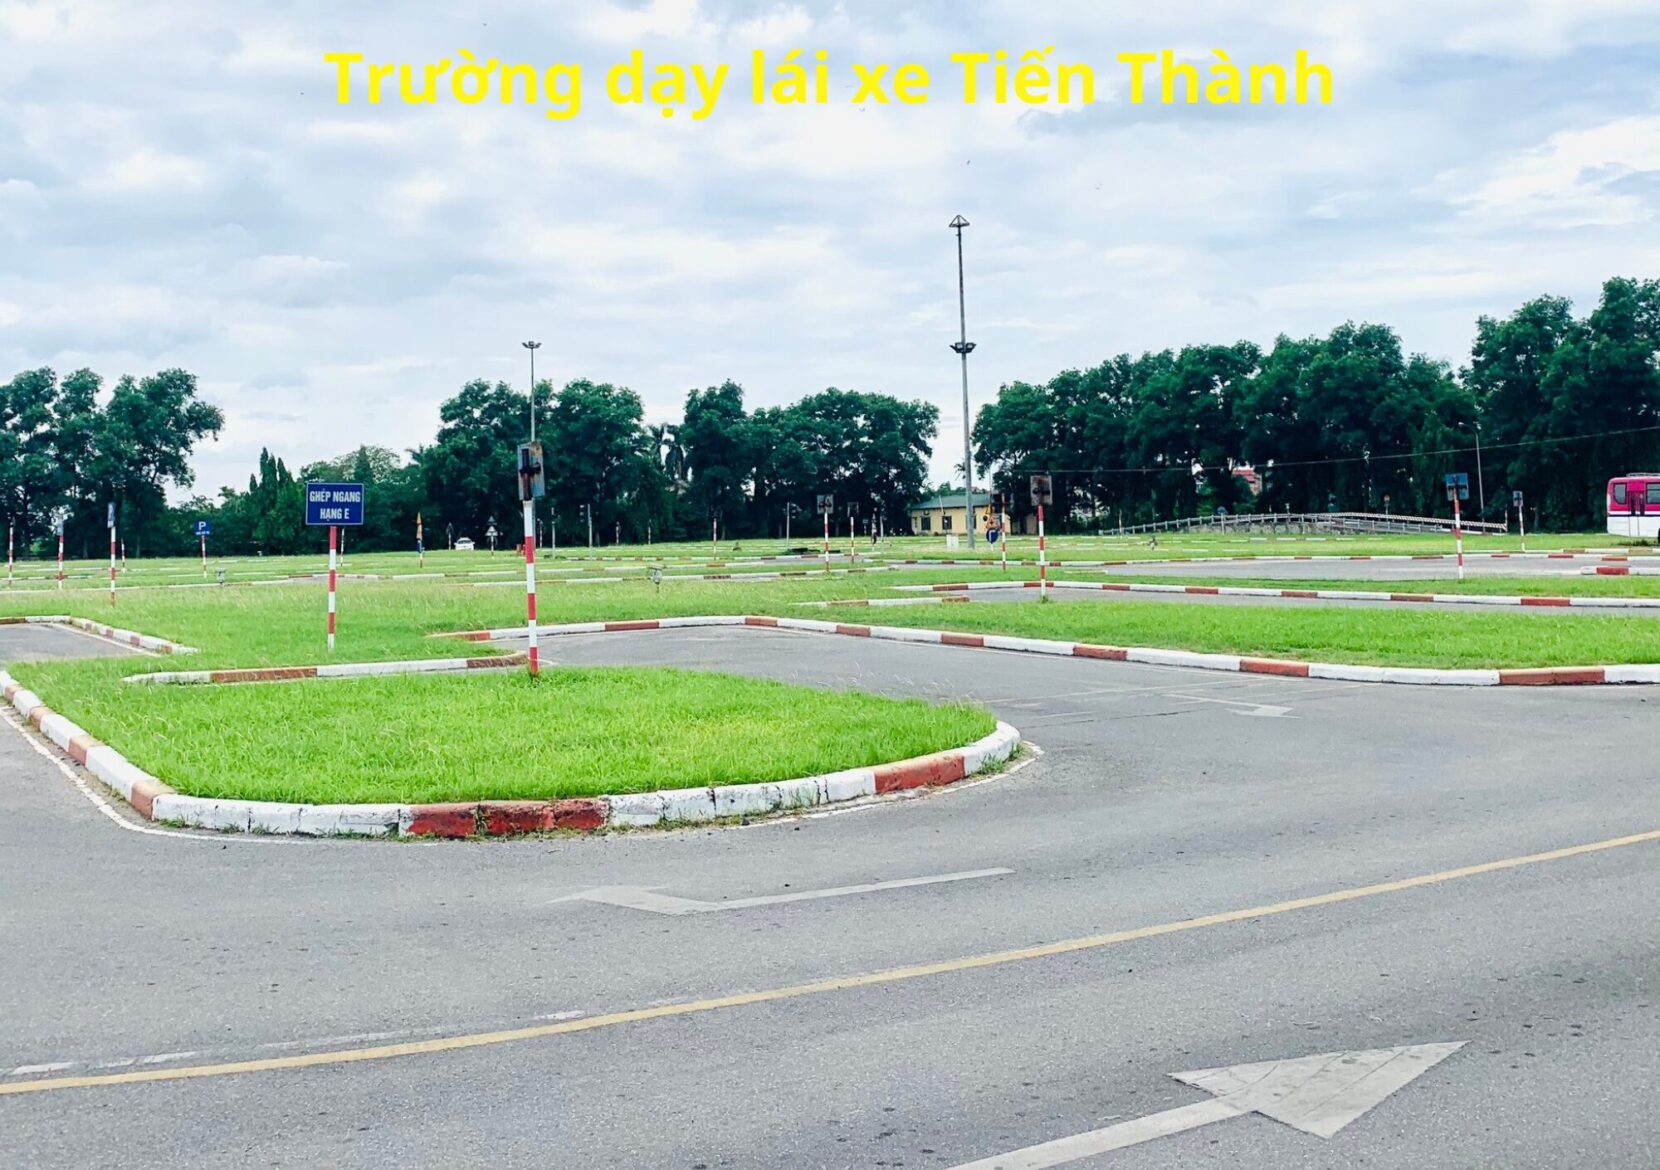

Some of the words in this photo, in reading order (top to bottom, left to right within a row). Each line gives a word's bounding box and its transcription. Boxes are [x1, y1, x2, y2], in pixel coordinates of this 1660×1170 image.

[332, 490, 361, 503] NGANG
[320, 508, 343, 522] HẠNG
[344, 508, 350, 520] E
[198, 521, 206, 531] P
